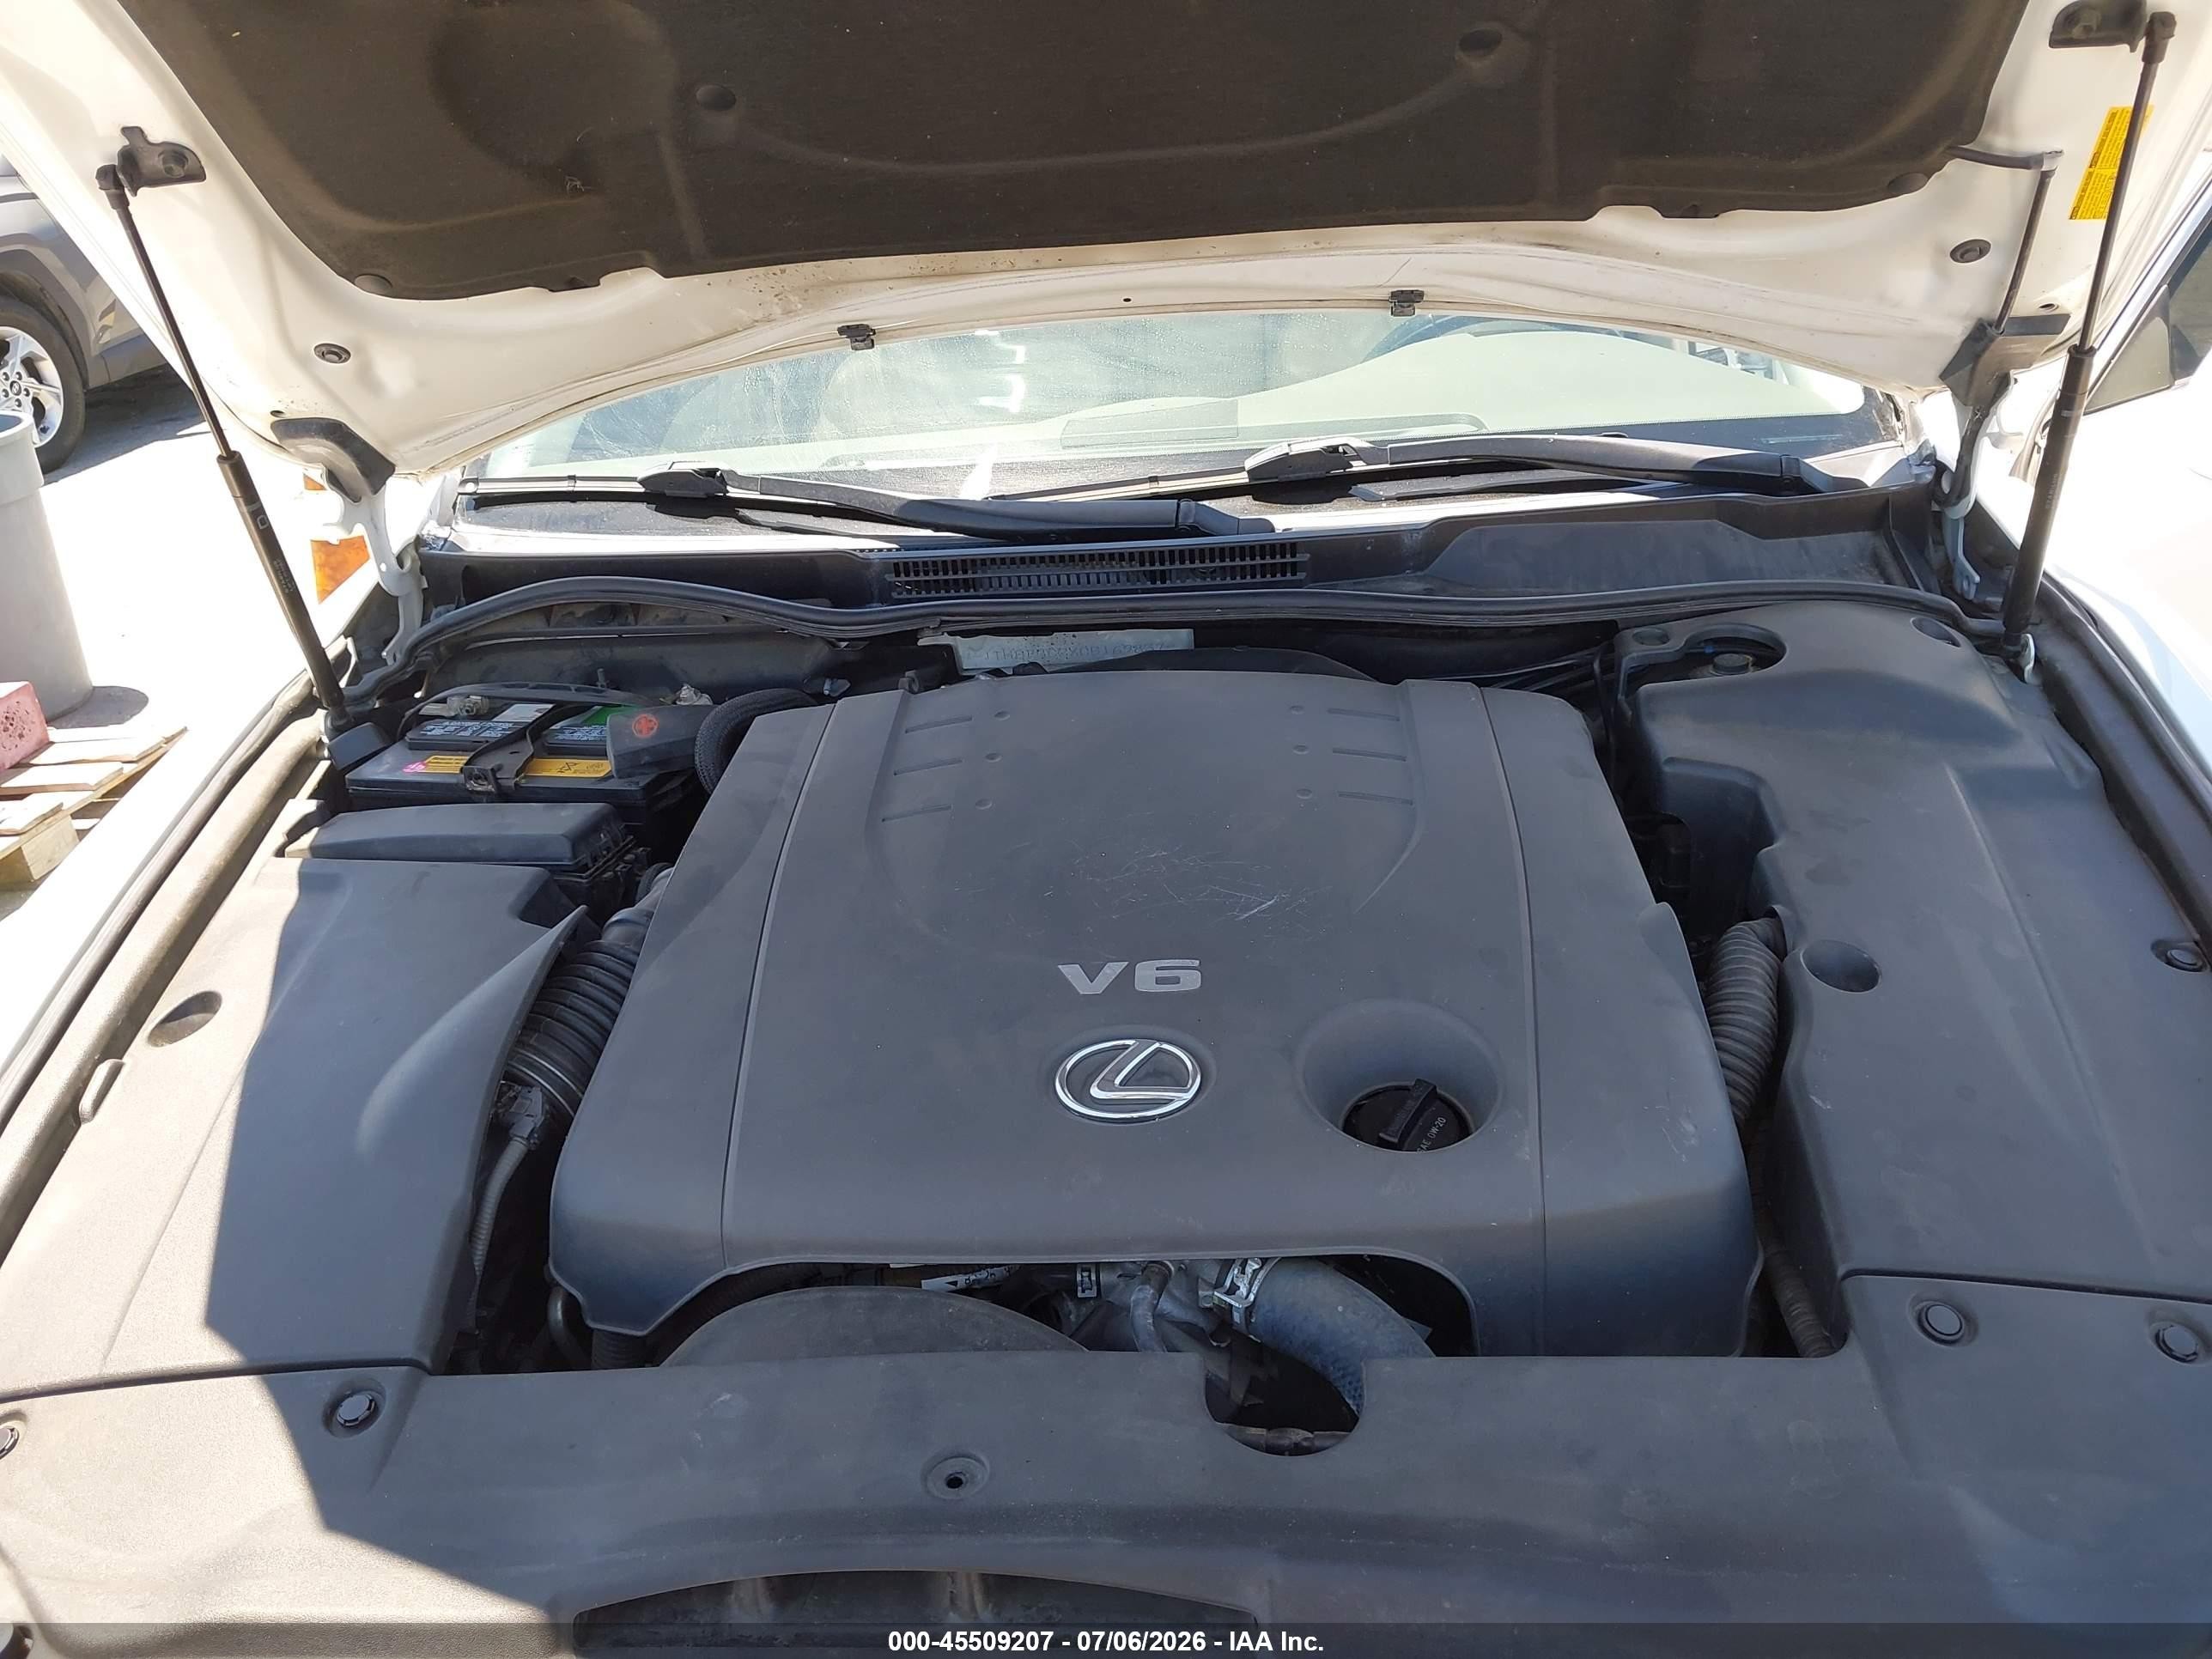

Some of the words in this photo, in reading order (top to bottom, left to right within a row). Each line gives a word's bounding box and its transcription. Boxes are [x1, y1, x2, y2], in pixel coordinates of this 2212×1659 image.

[1057, 958, 1202, 995] V6
[1417, 1139, 1431, 1153] SAE
[1427, 1116, 1447, 1139] 0W-20
